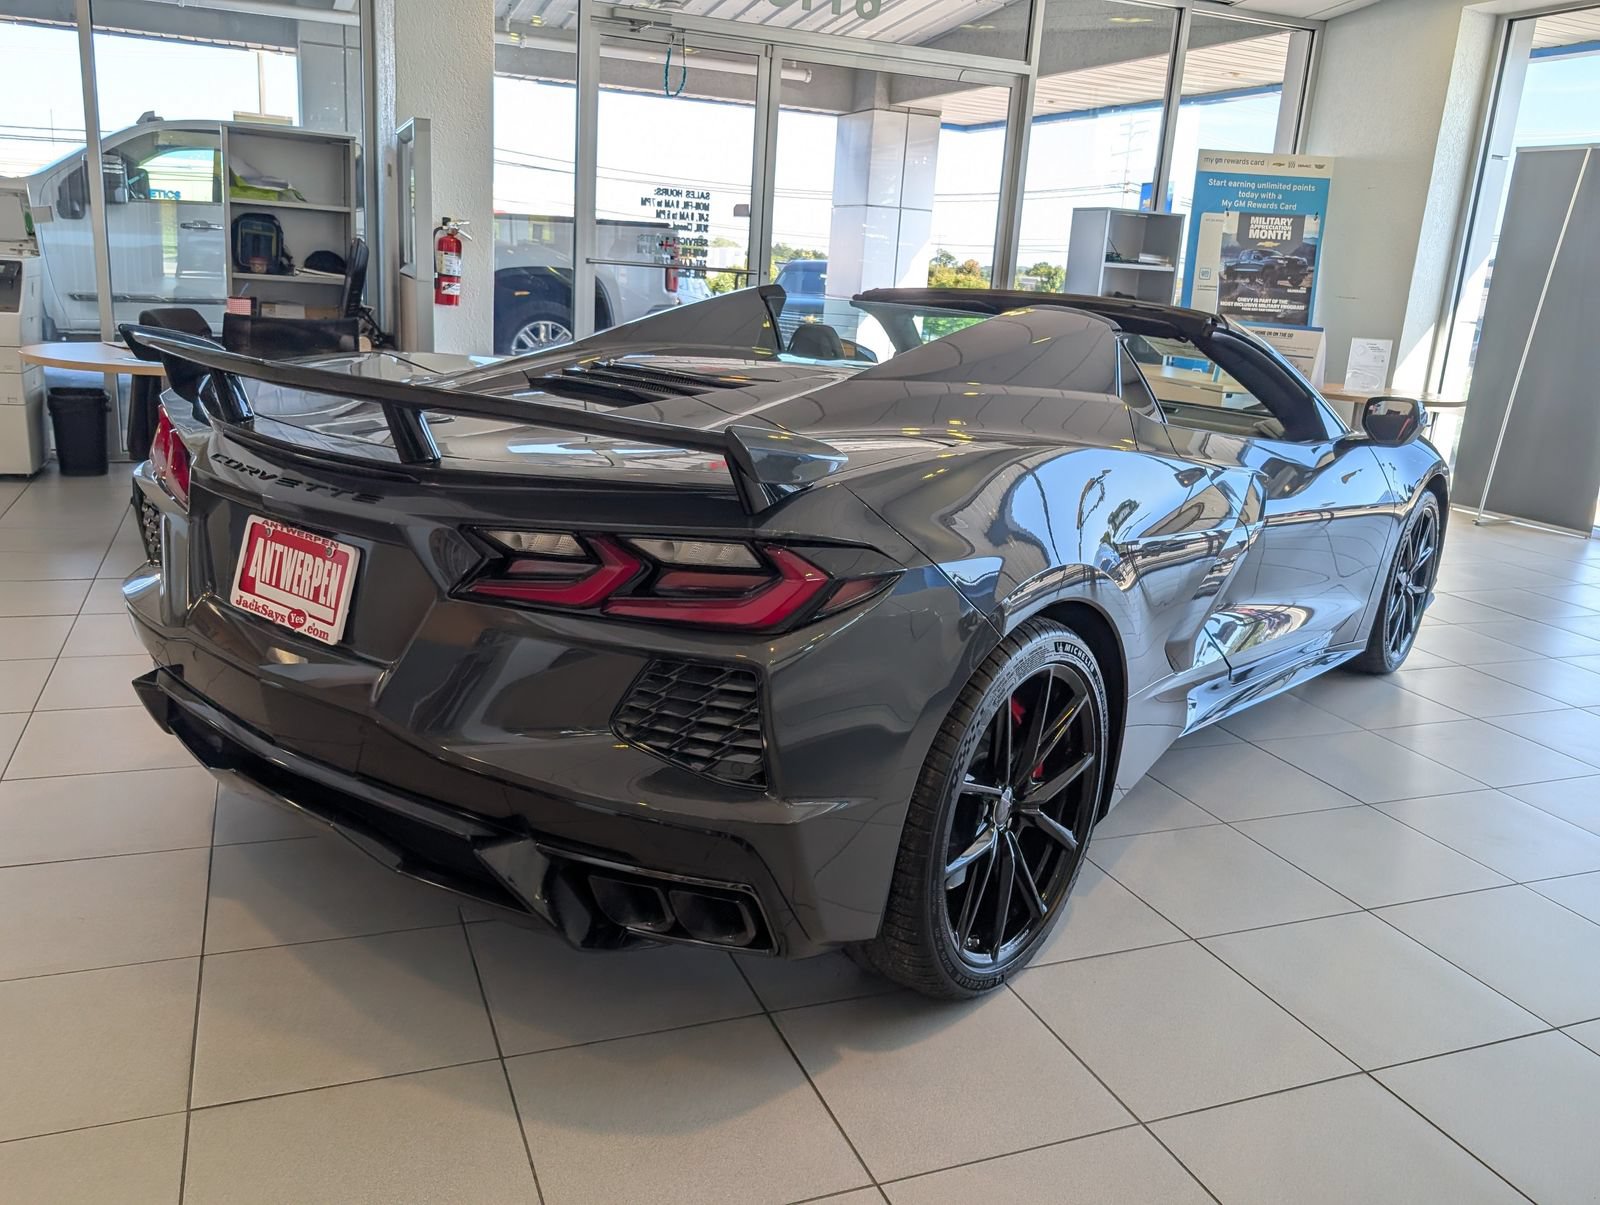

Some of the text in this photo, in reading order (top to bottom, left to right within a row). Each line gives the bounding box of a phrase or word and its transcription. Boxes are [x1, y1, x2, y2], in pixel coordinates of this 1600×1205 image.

[1208, 178, 1316, 192] Start earning unlimited points
[1238, 190, 1259, 200] today
[1260, 191, 1276, 199] with
[1221, 199, 1297, 211] My GM Rewards Card
[1250, 216, 1293, 226] MILITARY
[1248, 229, 1292, 241] MONTH
[211, 453, 385, 505] CORVETTE
[262, 519, 340, 549] ANTWERPEN
[248, 537, 343, 609] ANTWERPEN
[1064, 643, 1096, 673] MICHELIN
